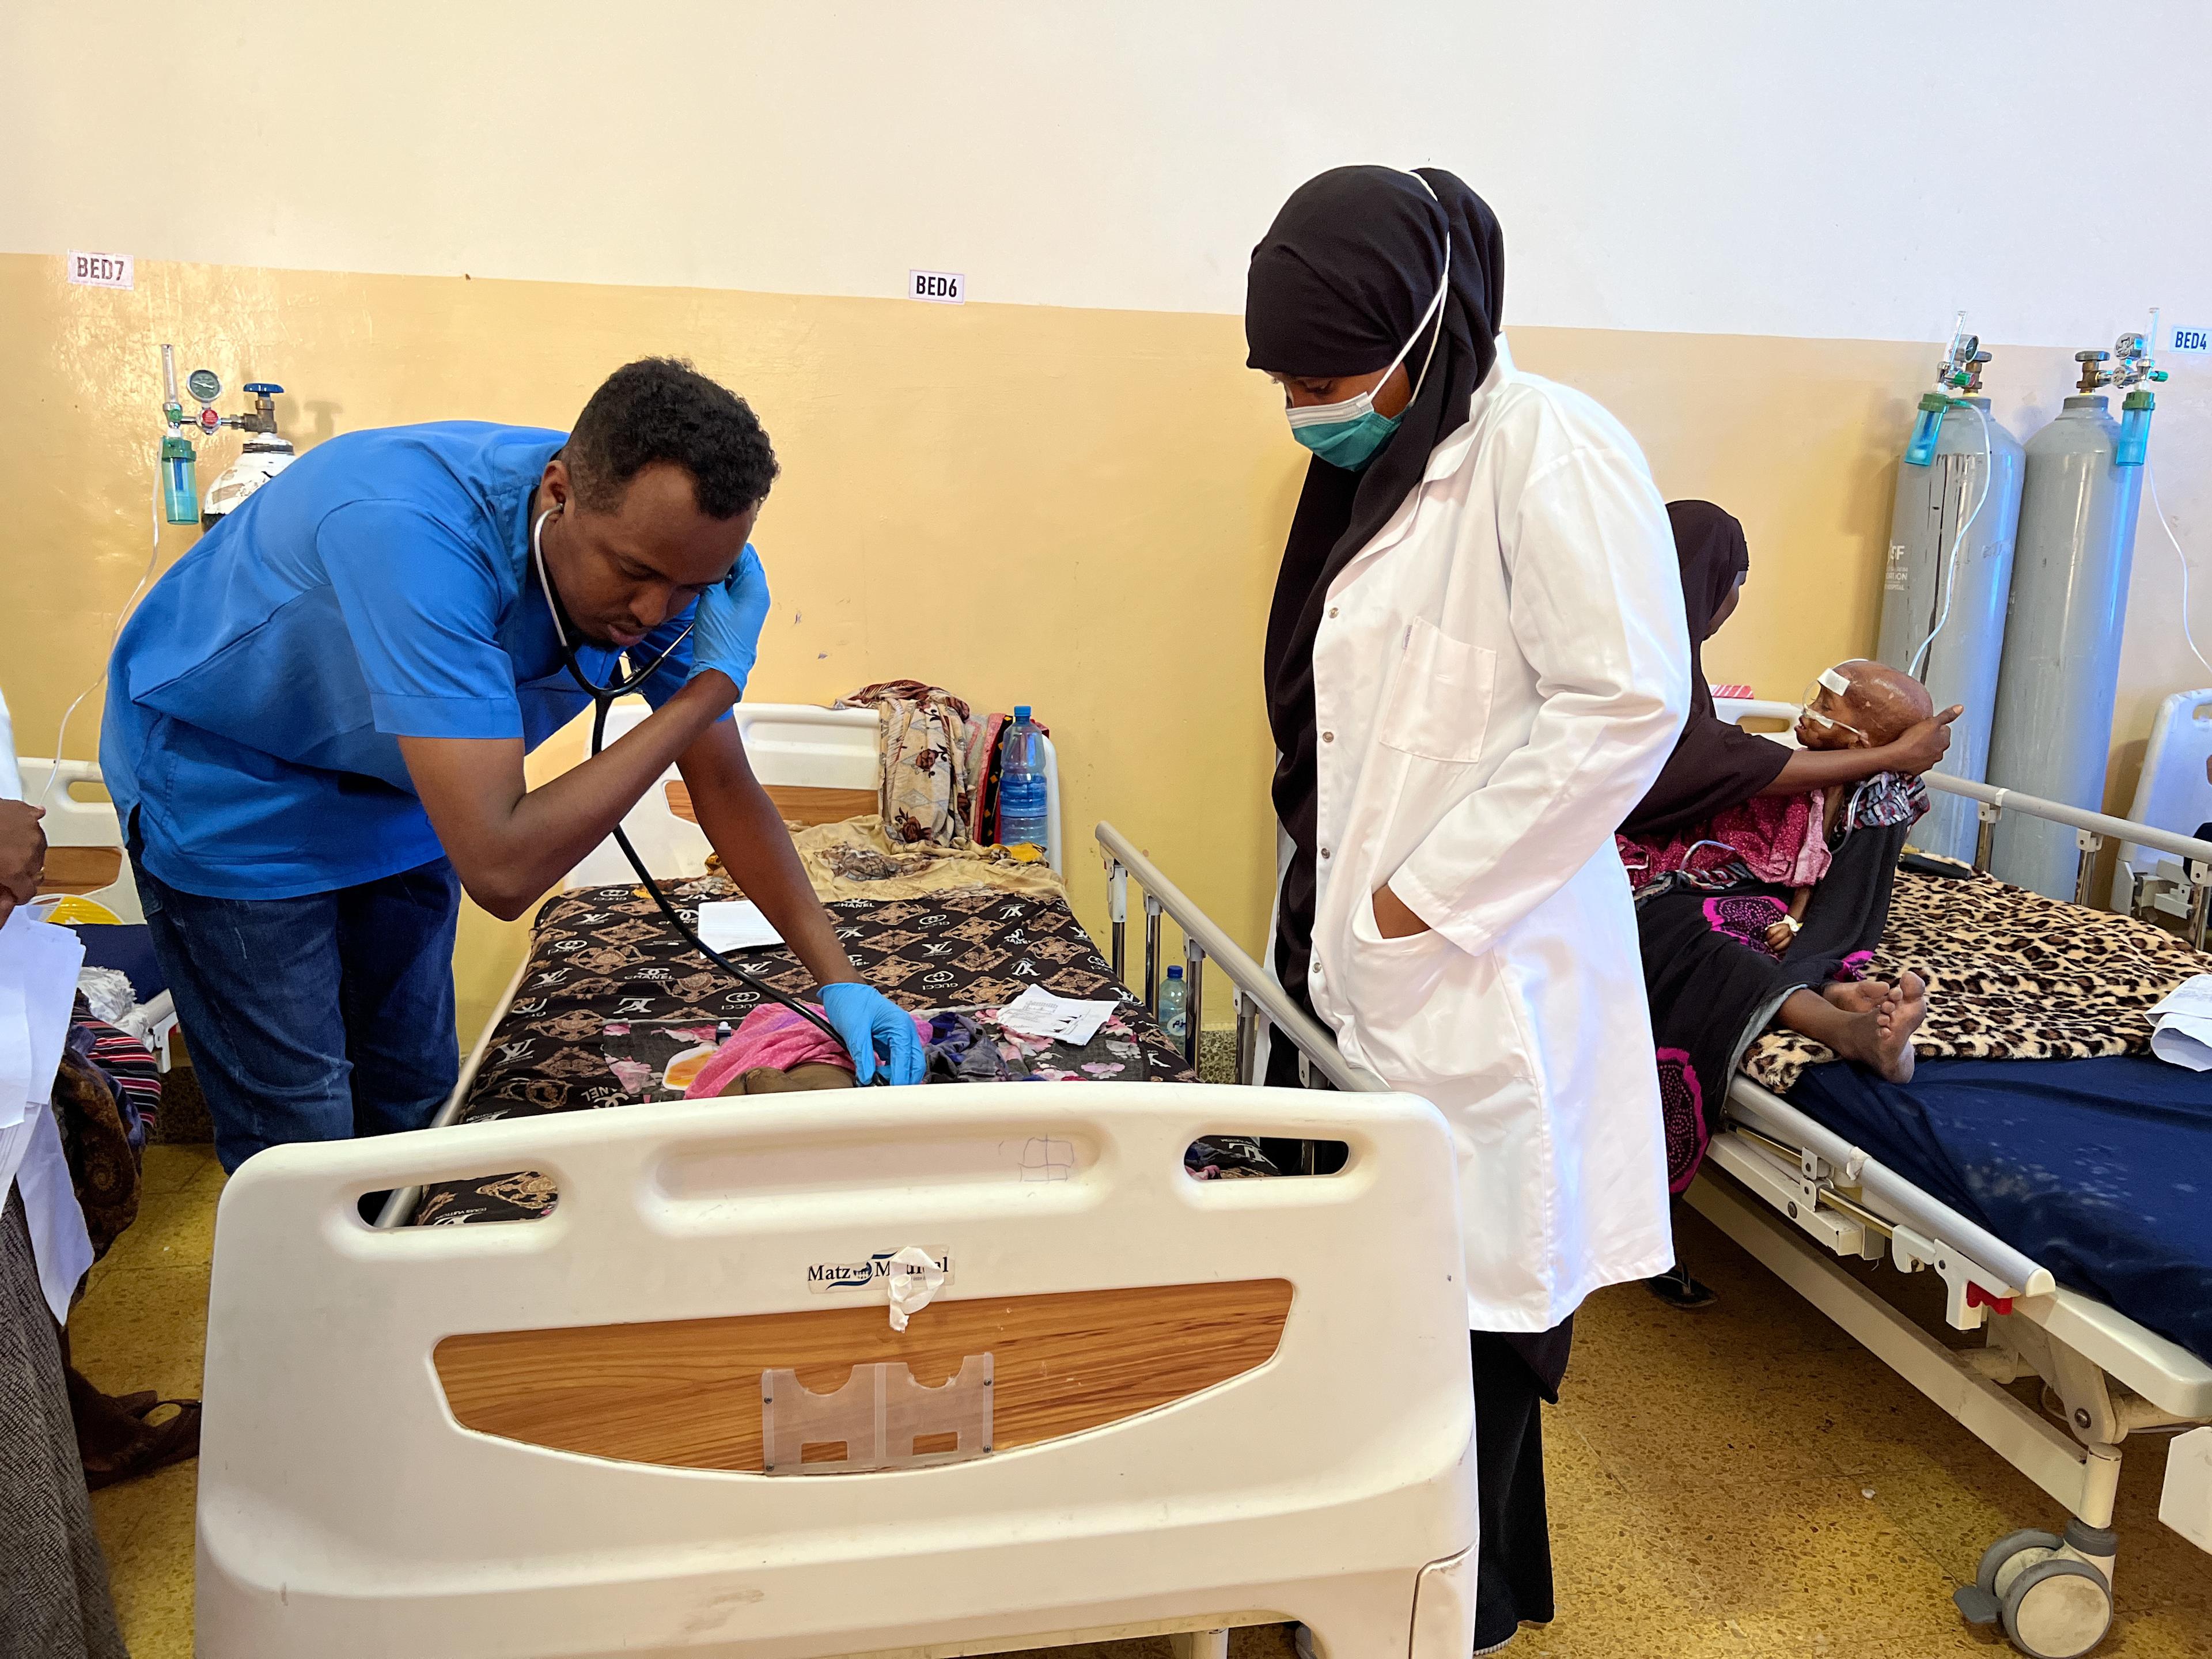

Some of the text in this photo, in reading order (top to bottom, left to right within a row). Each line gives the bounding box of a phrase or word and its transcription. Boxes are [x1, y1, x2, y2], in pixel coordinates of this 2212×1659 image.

[77, 256, 124, 281] BED7
[916, 275, 957, 298] BED6
[2175, 331, 2207, 350] BED4
[922, 982, 959, 991] GUCCI
[808, 1265, 850, 1282] Matz
